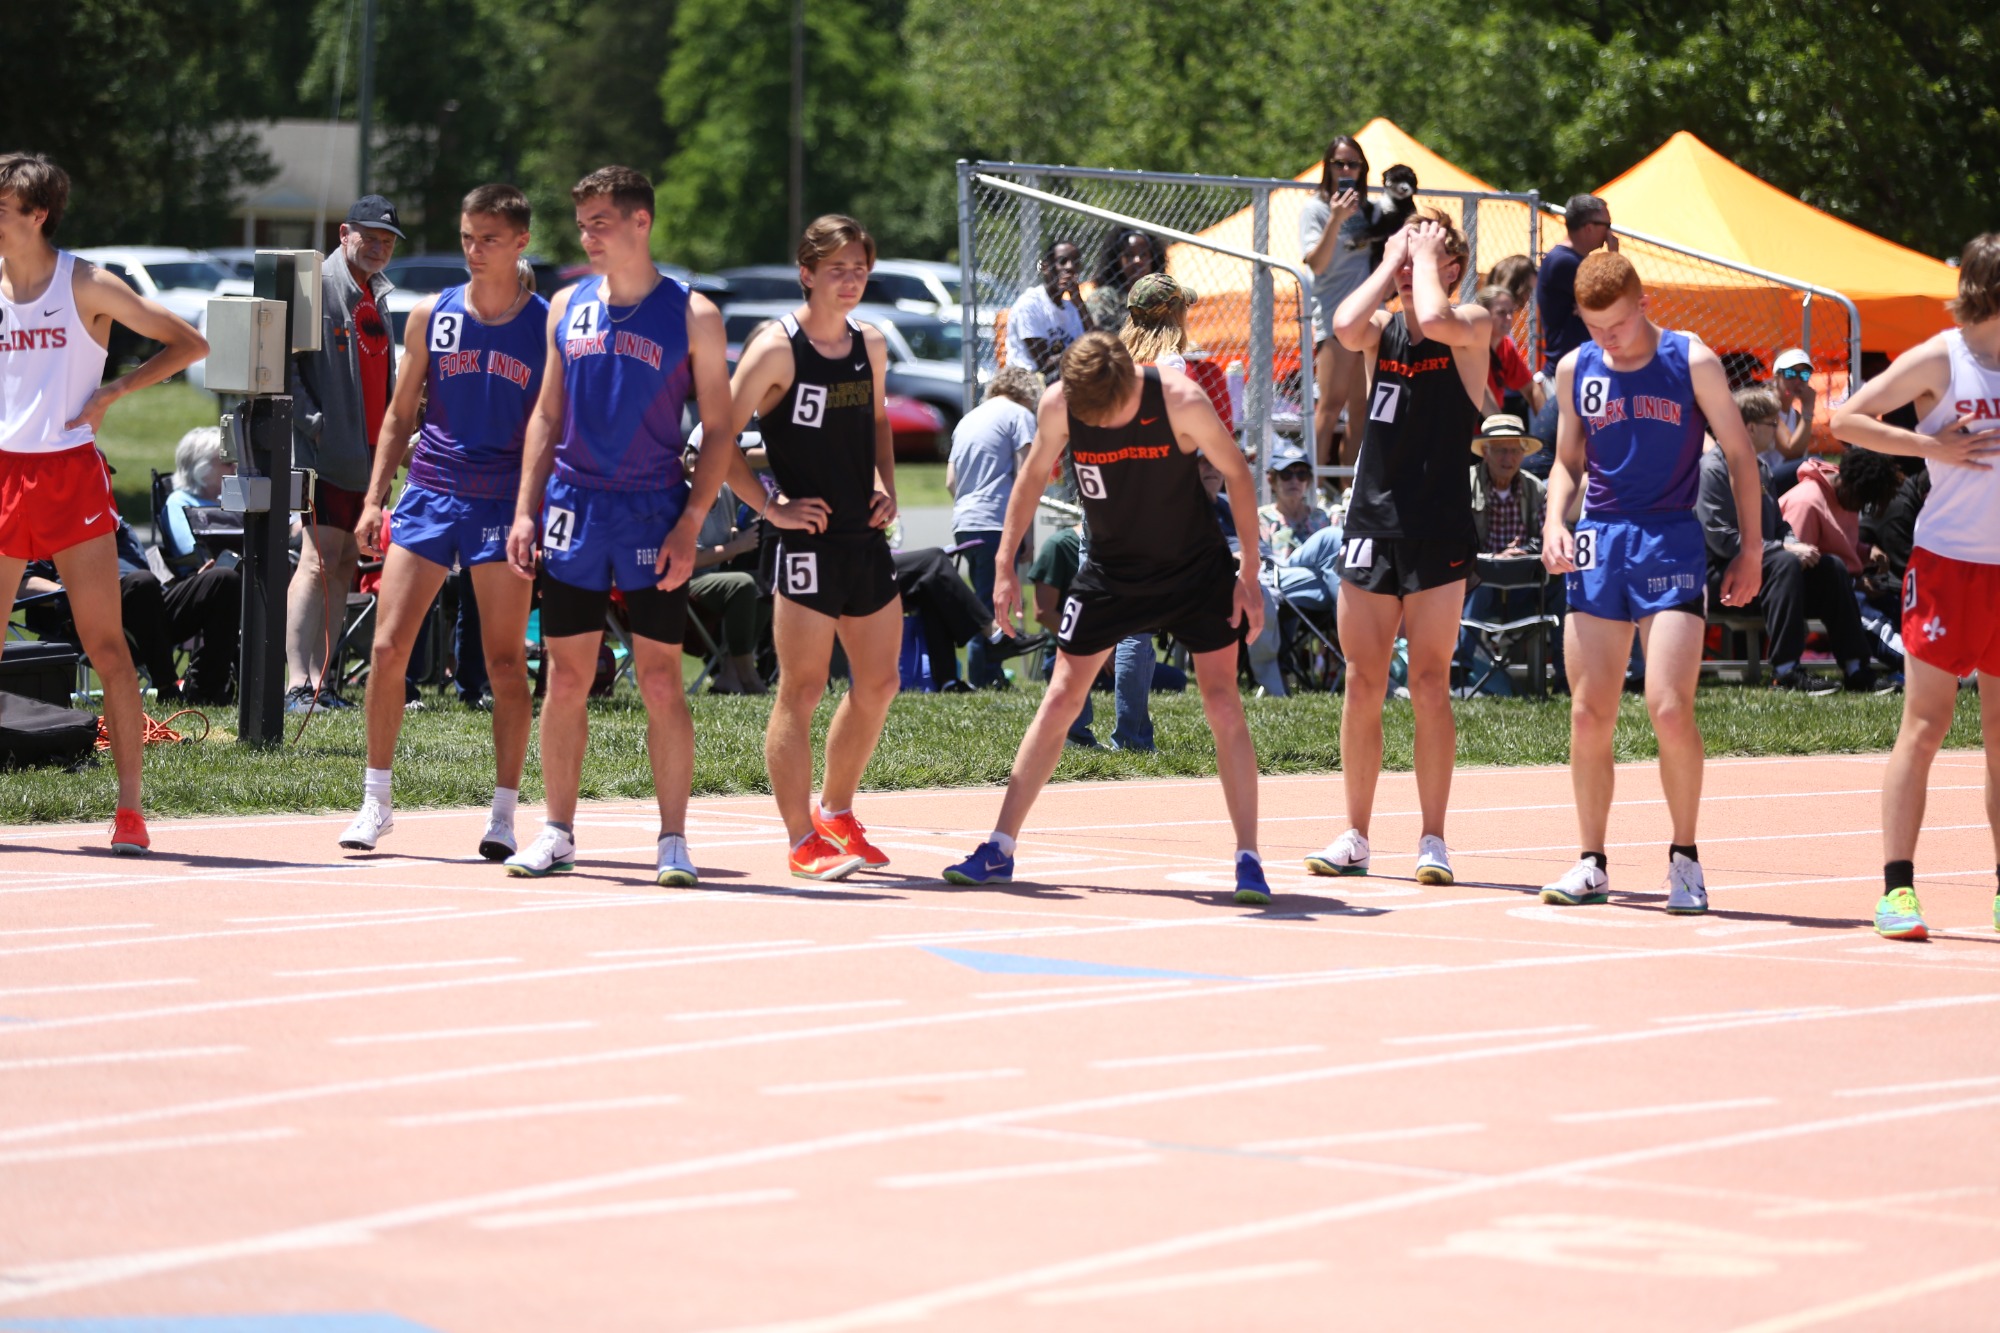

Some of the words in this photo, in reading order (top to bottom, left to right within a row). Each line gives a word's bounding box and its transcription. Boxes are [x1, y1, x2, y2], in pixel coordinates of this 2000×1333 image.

[435, 315, 457, 349] 3
[572, 305, 593, 335] 4
[0, 326, 67, 352] INTS
[565, 330, 609, 366] FORK
[614, 330, 663, 370] UNION
[439, 349, 481, 380] FORK
[487, 350, 532, 390] UNION
[797, 387, 821, 423] 5
[1374, 385, 1395, 417] 7
[1583, 380, 1603, 414] 8
[1632, 395, 1681, 426] UNION
[1073, 445, 1170, 464] WOODBERRY
[1078, 467, 1100, 496] 6
[548, 511, 568, 547] 4
[1574, 534, 1591, 568] 8
[790, 556, 812, 591] 5
[1647, 576, 1668, 594] FORK
[1060, 601, 1076, 634] 6
